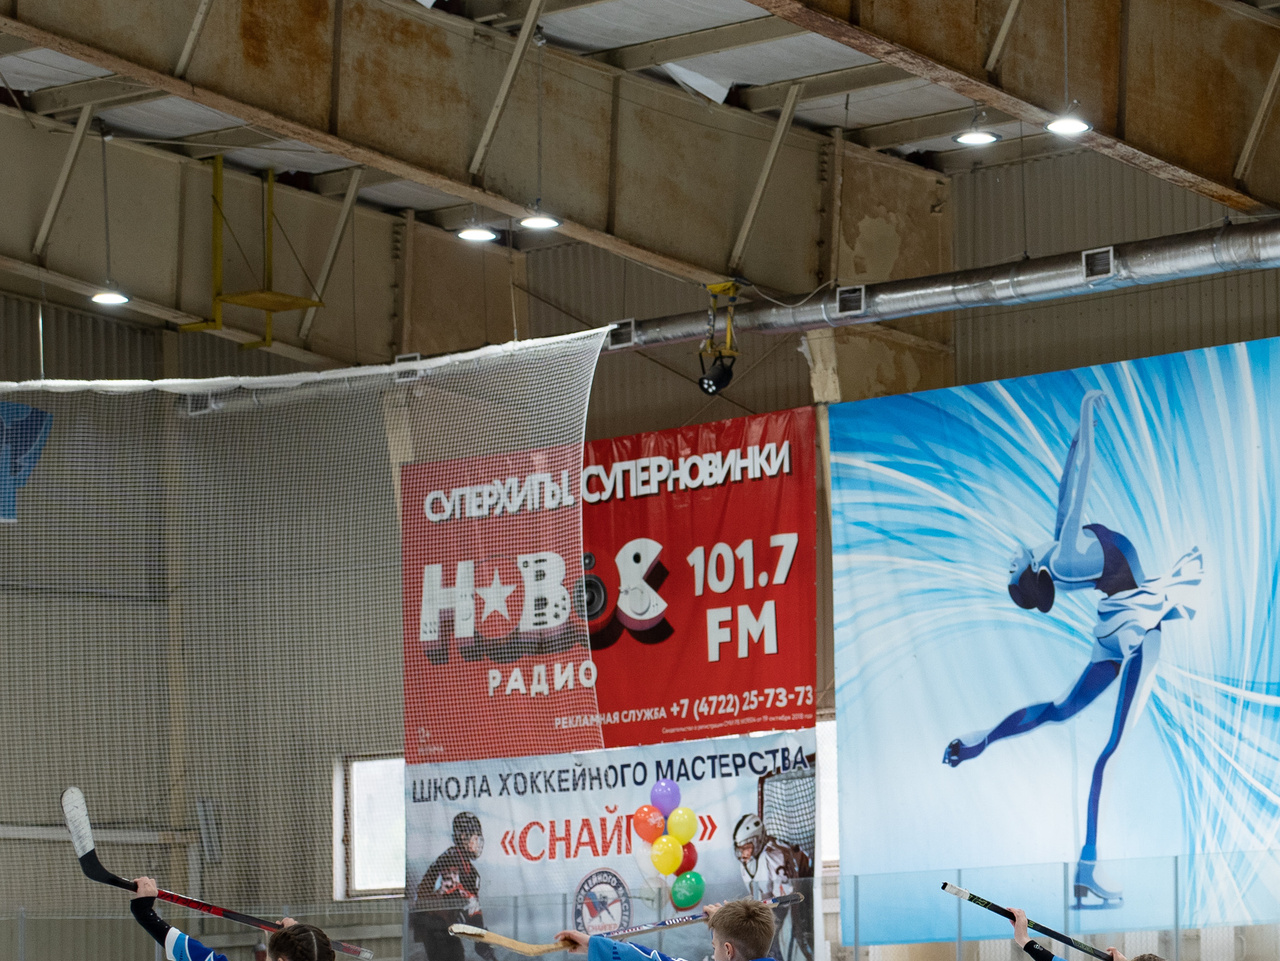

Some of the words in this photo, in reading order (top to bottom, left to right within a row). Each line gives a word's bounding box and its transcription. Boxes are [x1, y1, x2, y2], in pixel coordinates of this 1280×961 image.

[424, 472, 577, 523] СУПЕРХИТЫ
[580, 441, 792, 504] СУПЕРНОВИНКИ
[686, 532, 799, 598] 101.7
[706, 599, 779, 663] FM
[488, 660, 599, 698] РАДИО
[554, 711, 620, 730] РЕКЛАМНАЯ
[621, 706, 667, 725] СЛУЖБА
[670, 698, 690, 719] +7
[692, 693, 741, 721] (4722)
[741, 685, 814, 712] 25-73-73
[411, 774, 493, 803] ШКОЛА
[498, 760, 648, 797] ХОККЕЙНОГО
[655, 745, 810, 783] МАСТЕРСТВА
